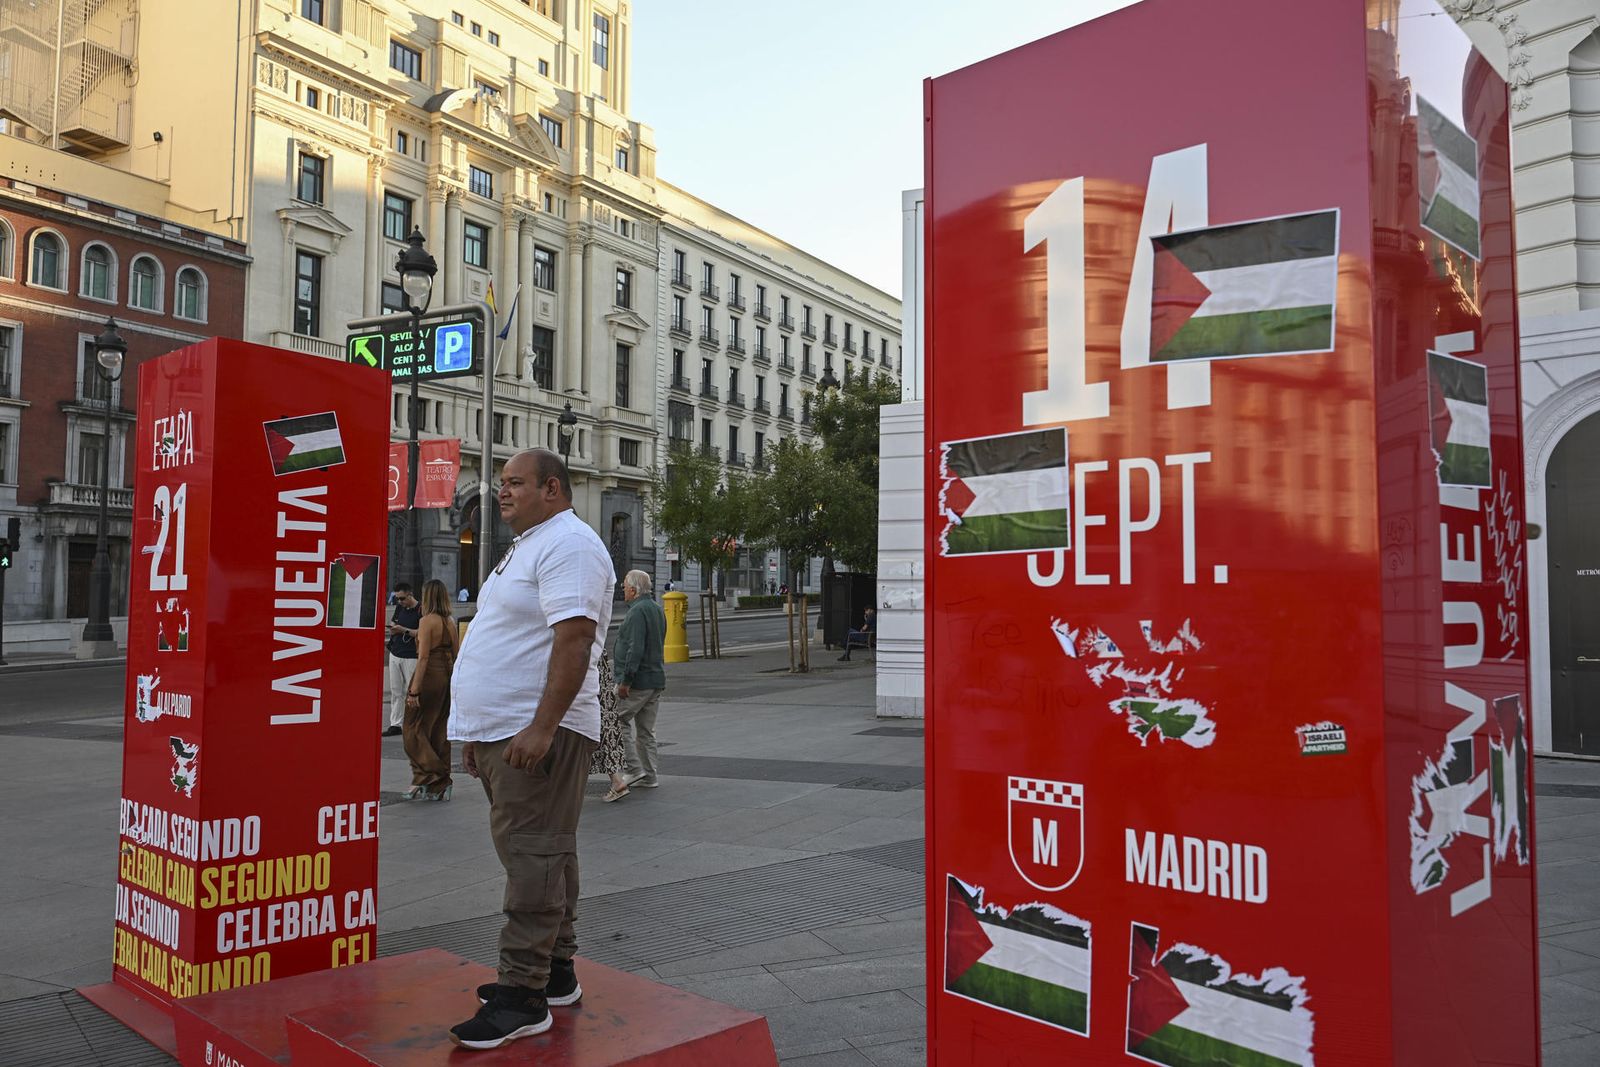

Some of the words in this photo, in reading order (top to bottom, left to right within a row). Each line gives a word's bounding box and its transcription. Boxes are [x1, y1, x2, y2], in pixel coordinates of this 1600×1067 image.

[1023, 143, 1211, 426] 14
[393, 353, 426, 365] CENTO
[444, 331, 463, 365] P
[152, 411, 194, 471] ETAPA
[149, 482, 188, 591] 21
[1027, 451, 1229, 587] EPT.
[1308, 732, 1343, 742] ISRAELI
[141, 804, 169, 850] CADA
[317, 801, 380, 845] CELE
[1033, 817, 1058, 867] M
[121, 841, 164, 896] CELEBRA
[165, 859, 196, 910] CADA
[200, 851, 332, 910] SEGUNDO
[1125, 828, 1268, 904] MADRID
[131, 890, 180, 951] SEGUNDO
[216, 895, 337, 954] CELEBRA
[343, 888, 377, 930] CA
[141, 940, 168, 992] CADA
